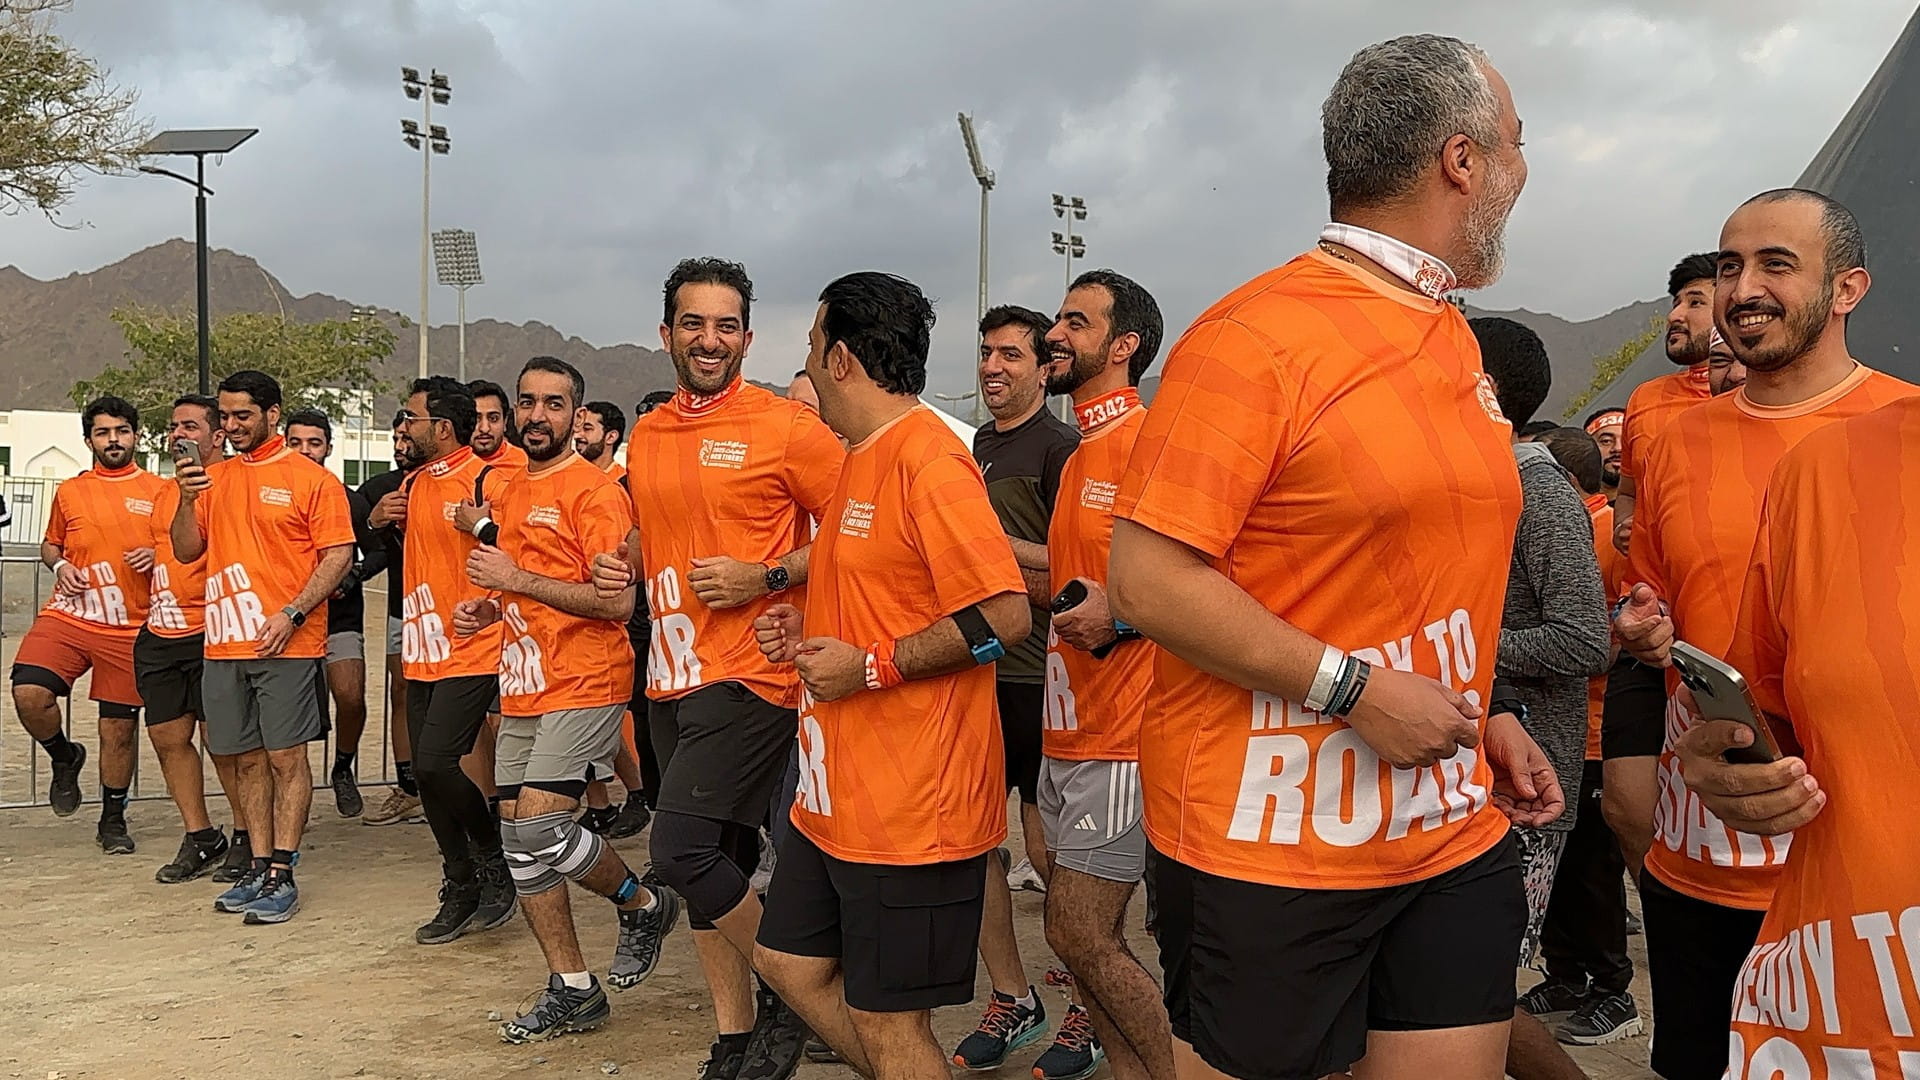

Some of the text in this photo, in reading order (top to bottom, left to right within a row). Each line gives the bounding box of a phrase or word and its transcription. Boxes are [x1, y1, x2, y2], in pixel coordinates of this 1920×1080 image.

[1084, 396, 1127, 427] 2342
[90, 561, 117, 586] TO
[223, 562, 252, 592] TO
[658, 566, 682, 612] TO
[1424, 608, 1477, 690] TO
